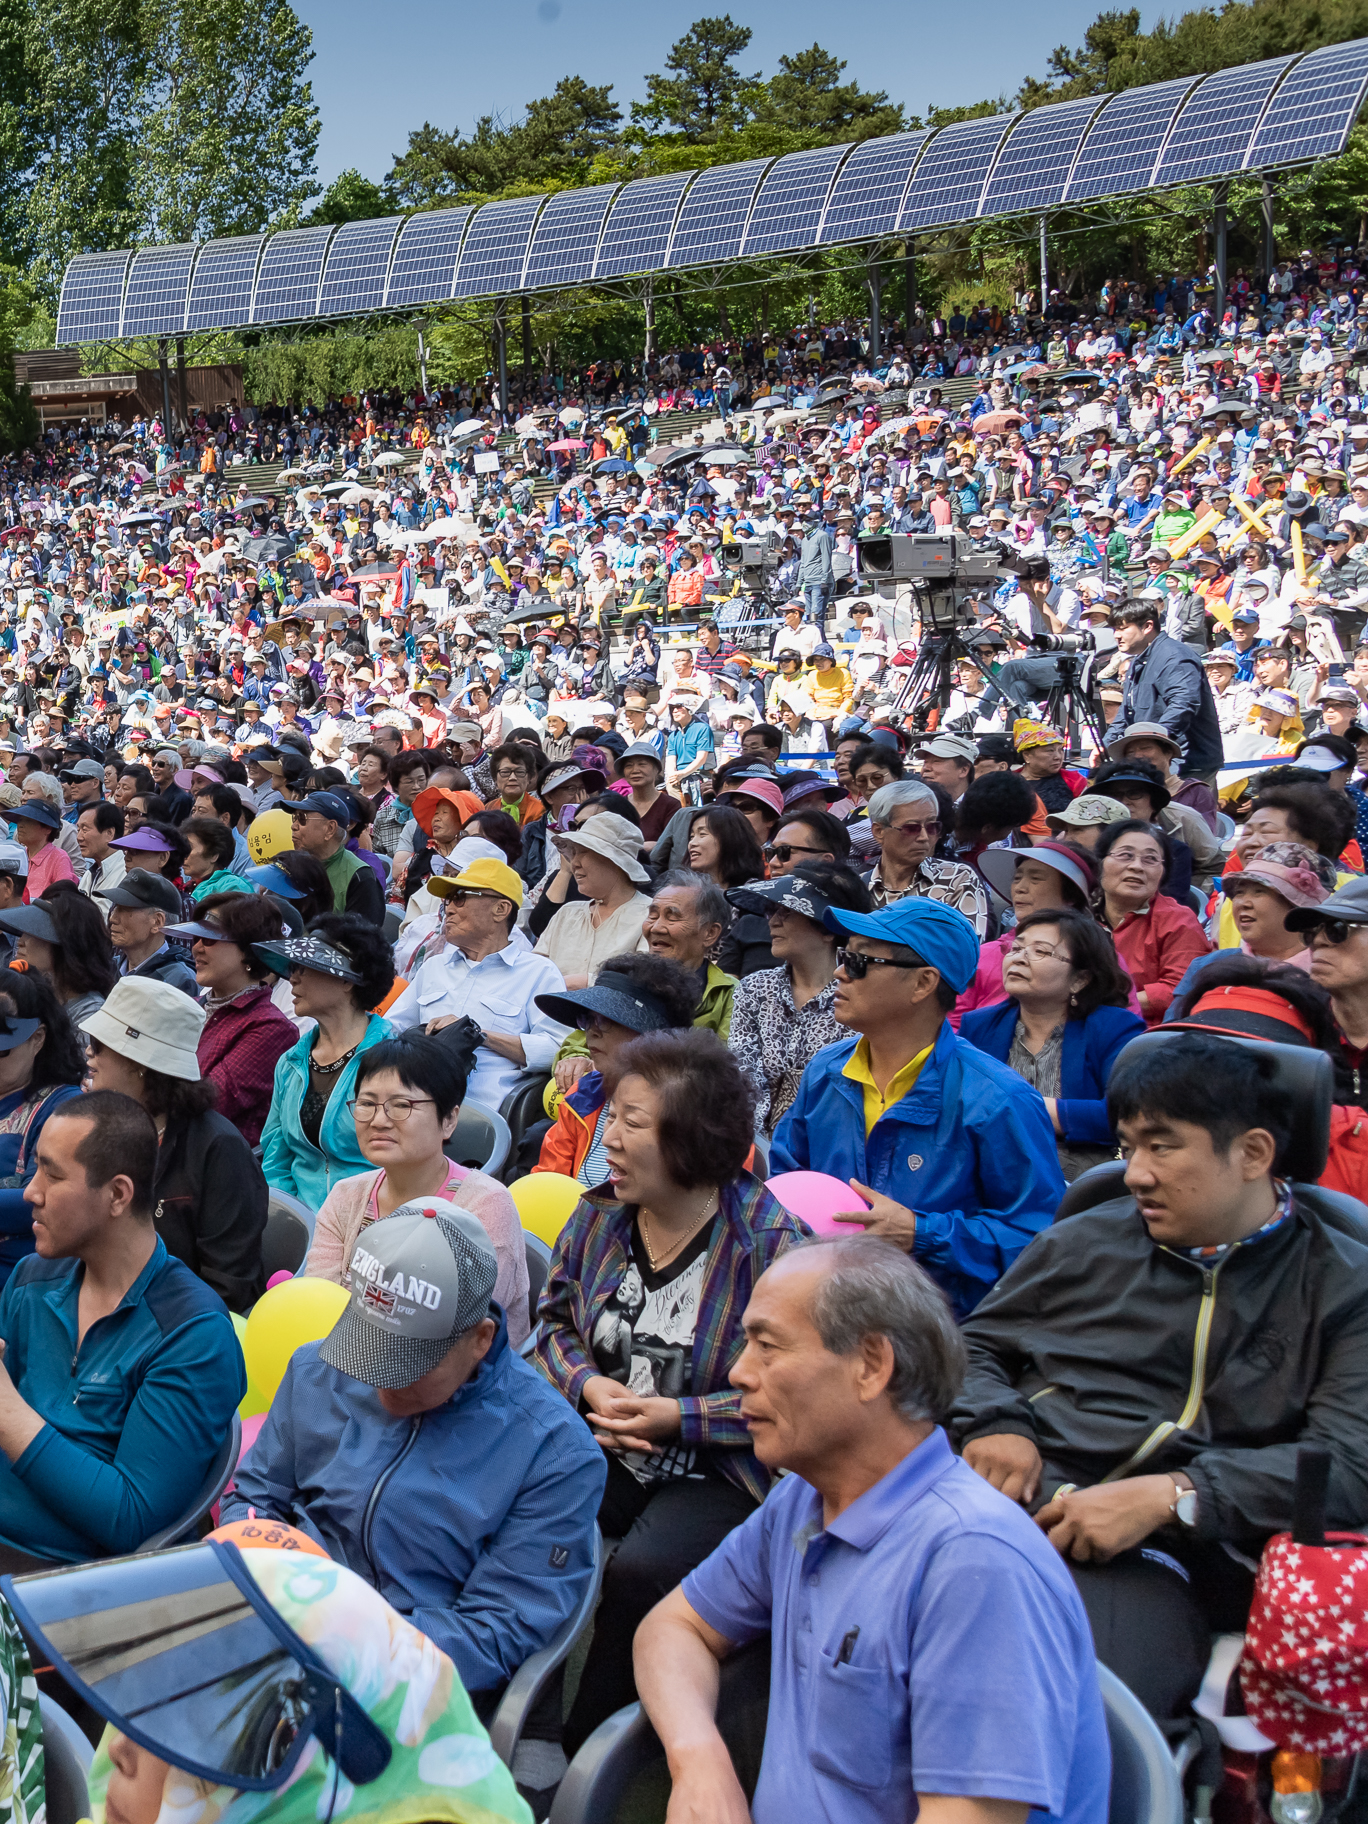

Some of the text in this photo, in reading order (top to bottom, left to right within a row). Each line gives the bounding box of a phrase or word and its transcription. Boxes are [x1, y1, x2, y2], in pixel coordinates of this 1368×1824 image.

[248, 833, 272, 848] 김용임
[351, 1247, 442, 1311] ENGLAND
[396, 1305, 418, 1317] 1707
